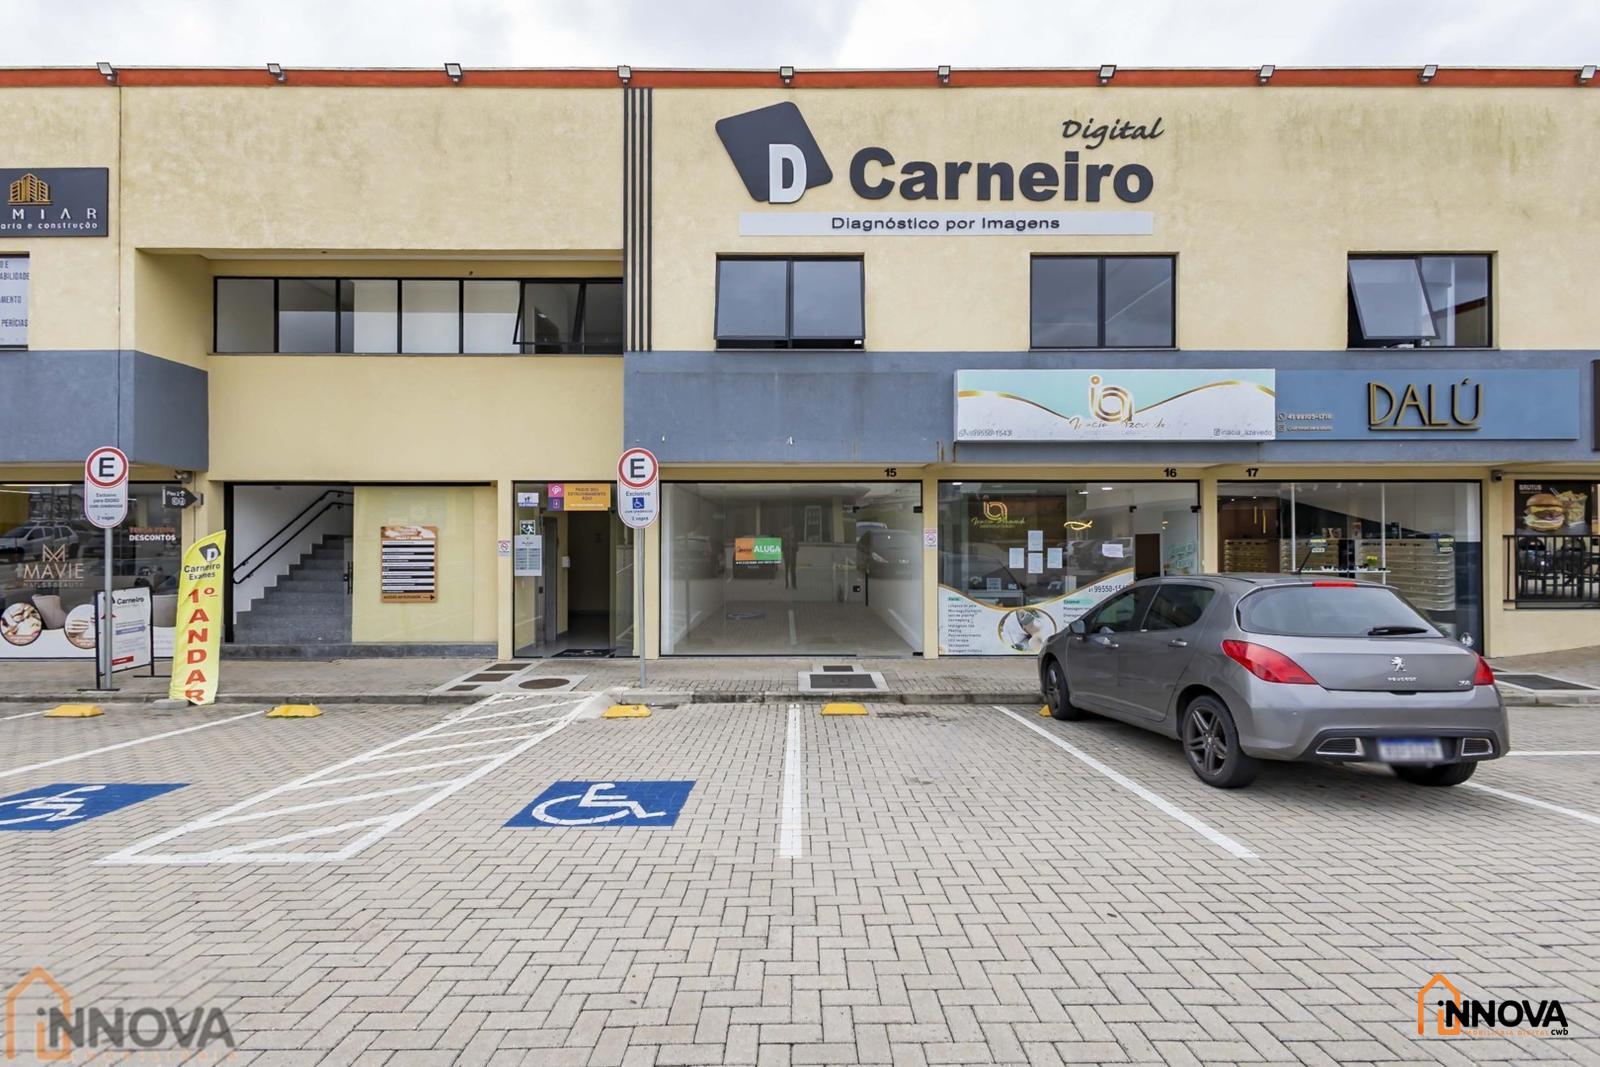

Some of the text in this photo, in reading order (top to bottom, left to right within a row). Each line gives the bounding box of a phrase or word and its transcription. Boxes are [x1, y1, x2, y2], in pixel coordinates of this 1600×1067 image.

[1062, 117, 1165, 149] Digital
[769, 143, 807, 203] D
[850, 147, 1154, 203] Carneiro
[38, 221, 98, 230] construção
[831, 216, 1060, 232] Diagnóstico por Imagens
[1367, 378, 1483, 426] DALÚ
[99, 457, 115, 477] E
[630, 458, 645, 478] E
[885, 468, 897, 477] 15
[1164, 468, 1177, 478] 16
[1246, 468, 1259, 477] 17
[754, 545, 781, 553] ALUGA
[24, 563, 84, 579] MAVIE
[184, 563, 220, 573] Carneiro
[189, 572, 216, 581] Exames
[185, 608, 210, 702] ANDAR
